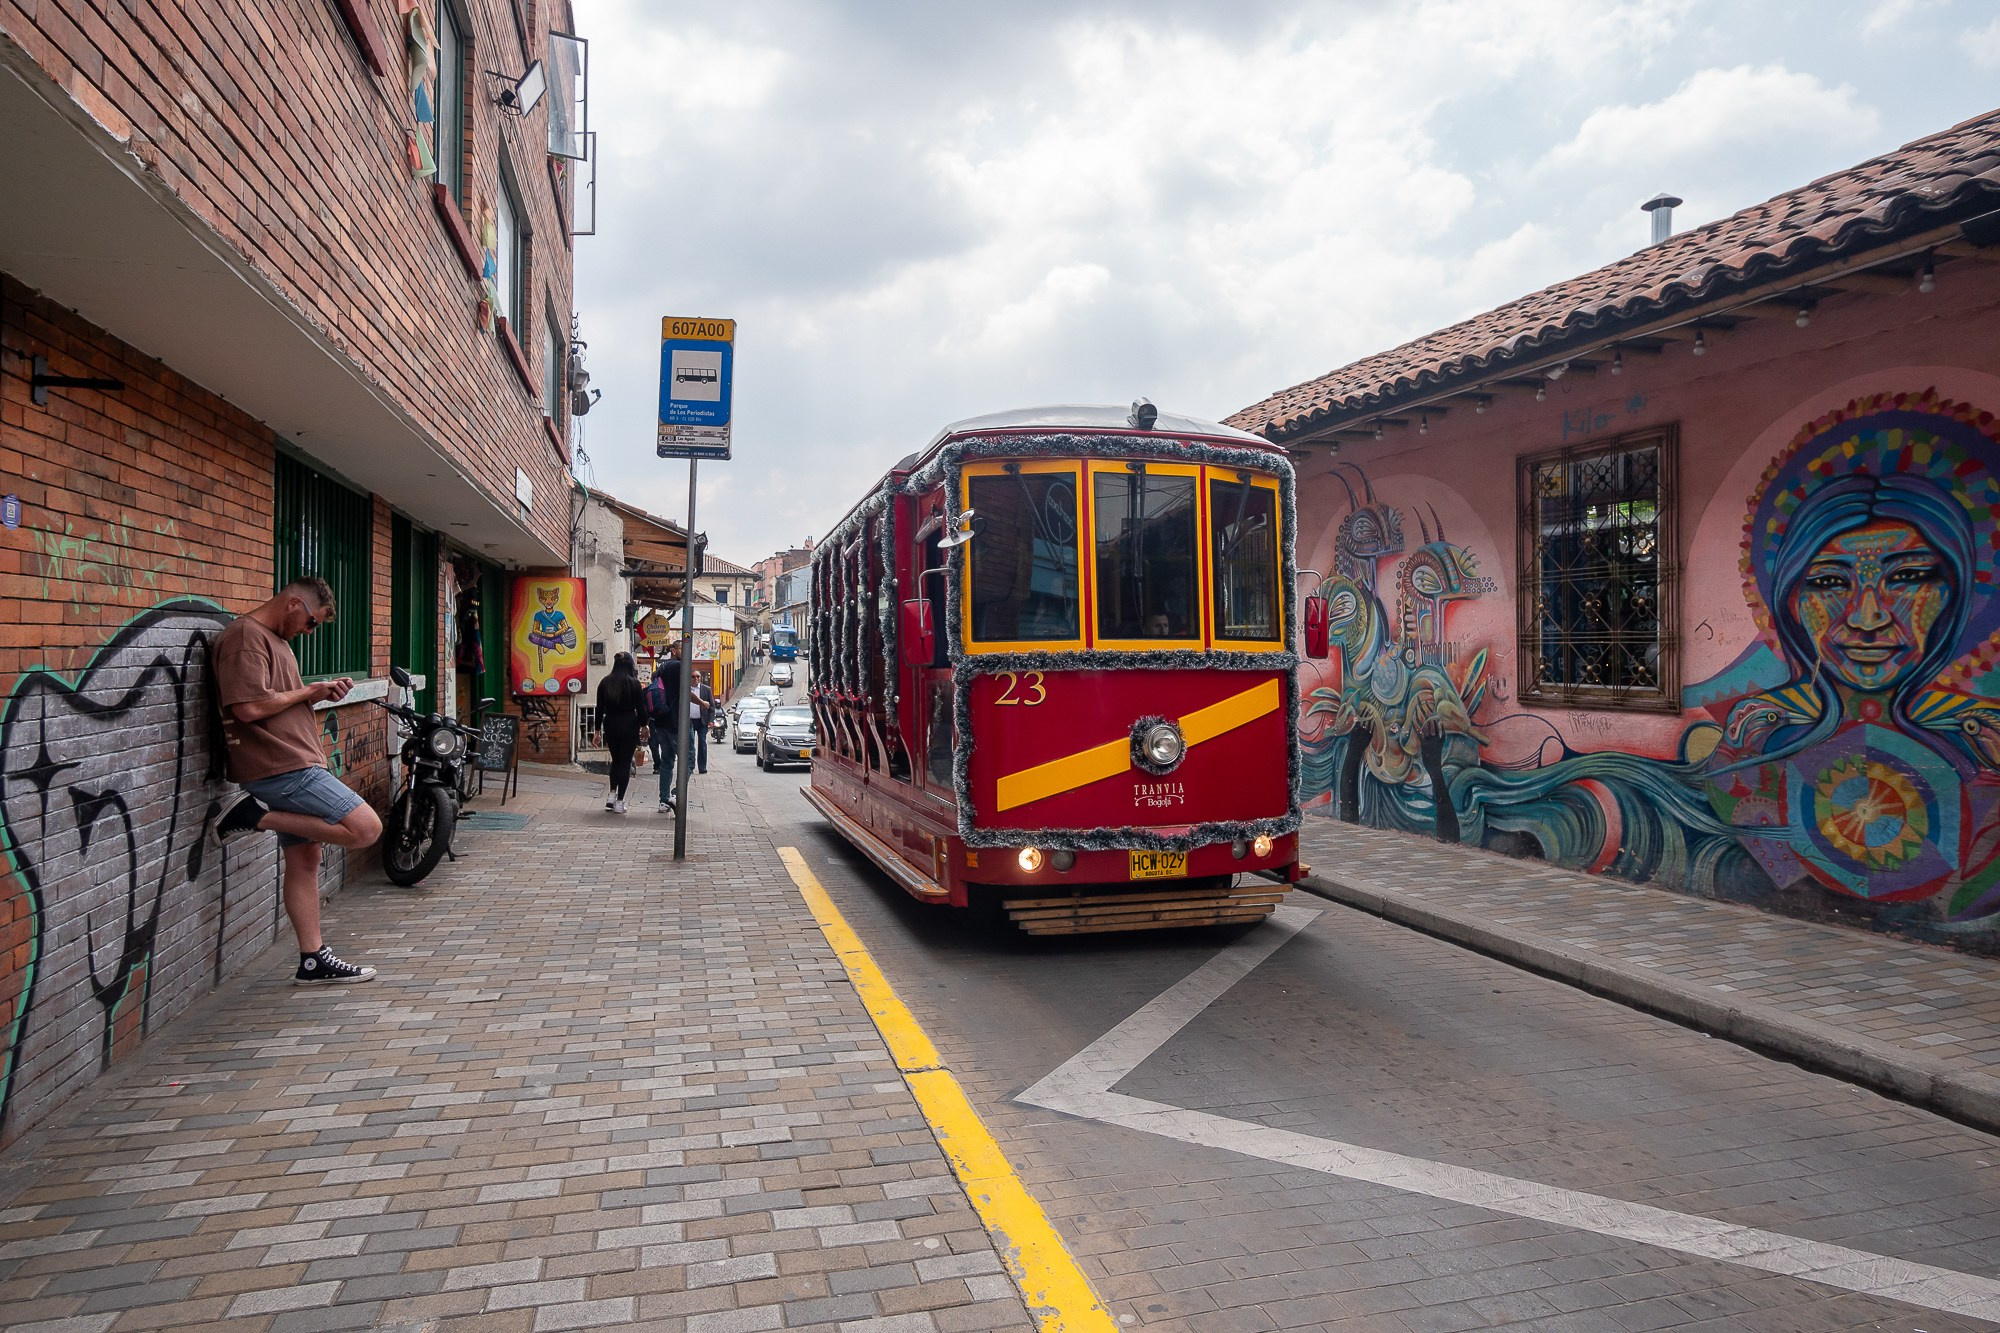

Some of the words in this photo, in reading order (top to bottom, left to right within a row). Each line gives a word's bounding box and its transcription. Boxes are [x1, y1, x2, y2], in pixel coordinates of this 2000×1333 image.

[672, 321, 725, 337] 607A00
[994, 671, 1047, 706] 23
[1133, 782, 1185, 796] TRANVIA
[1147, 796, 1172, 808] Bogotá
[1145, 869, 1164, 877] BOGOTA
